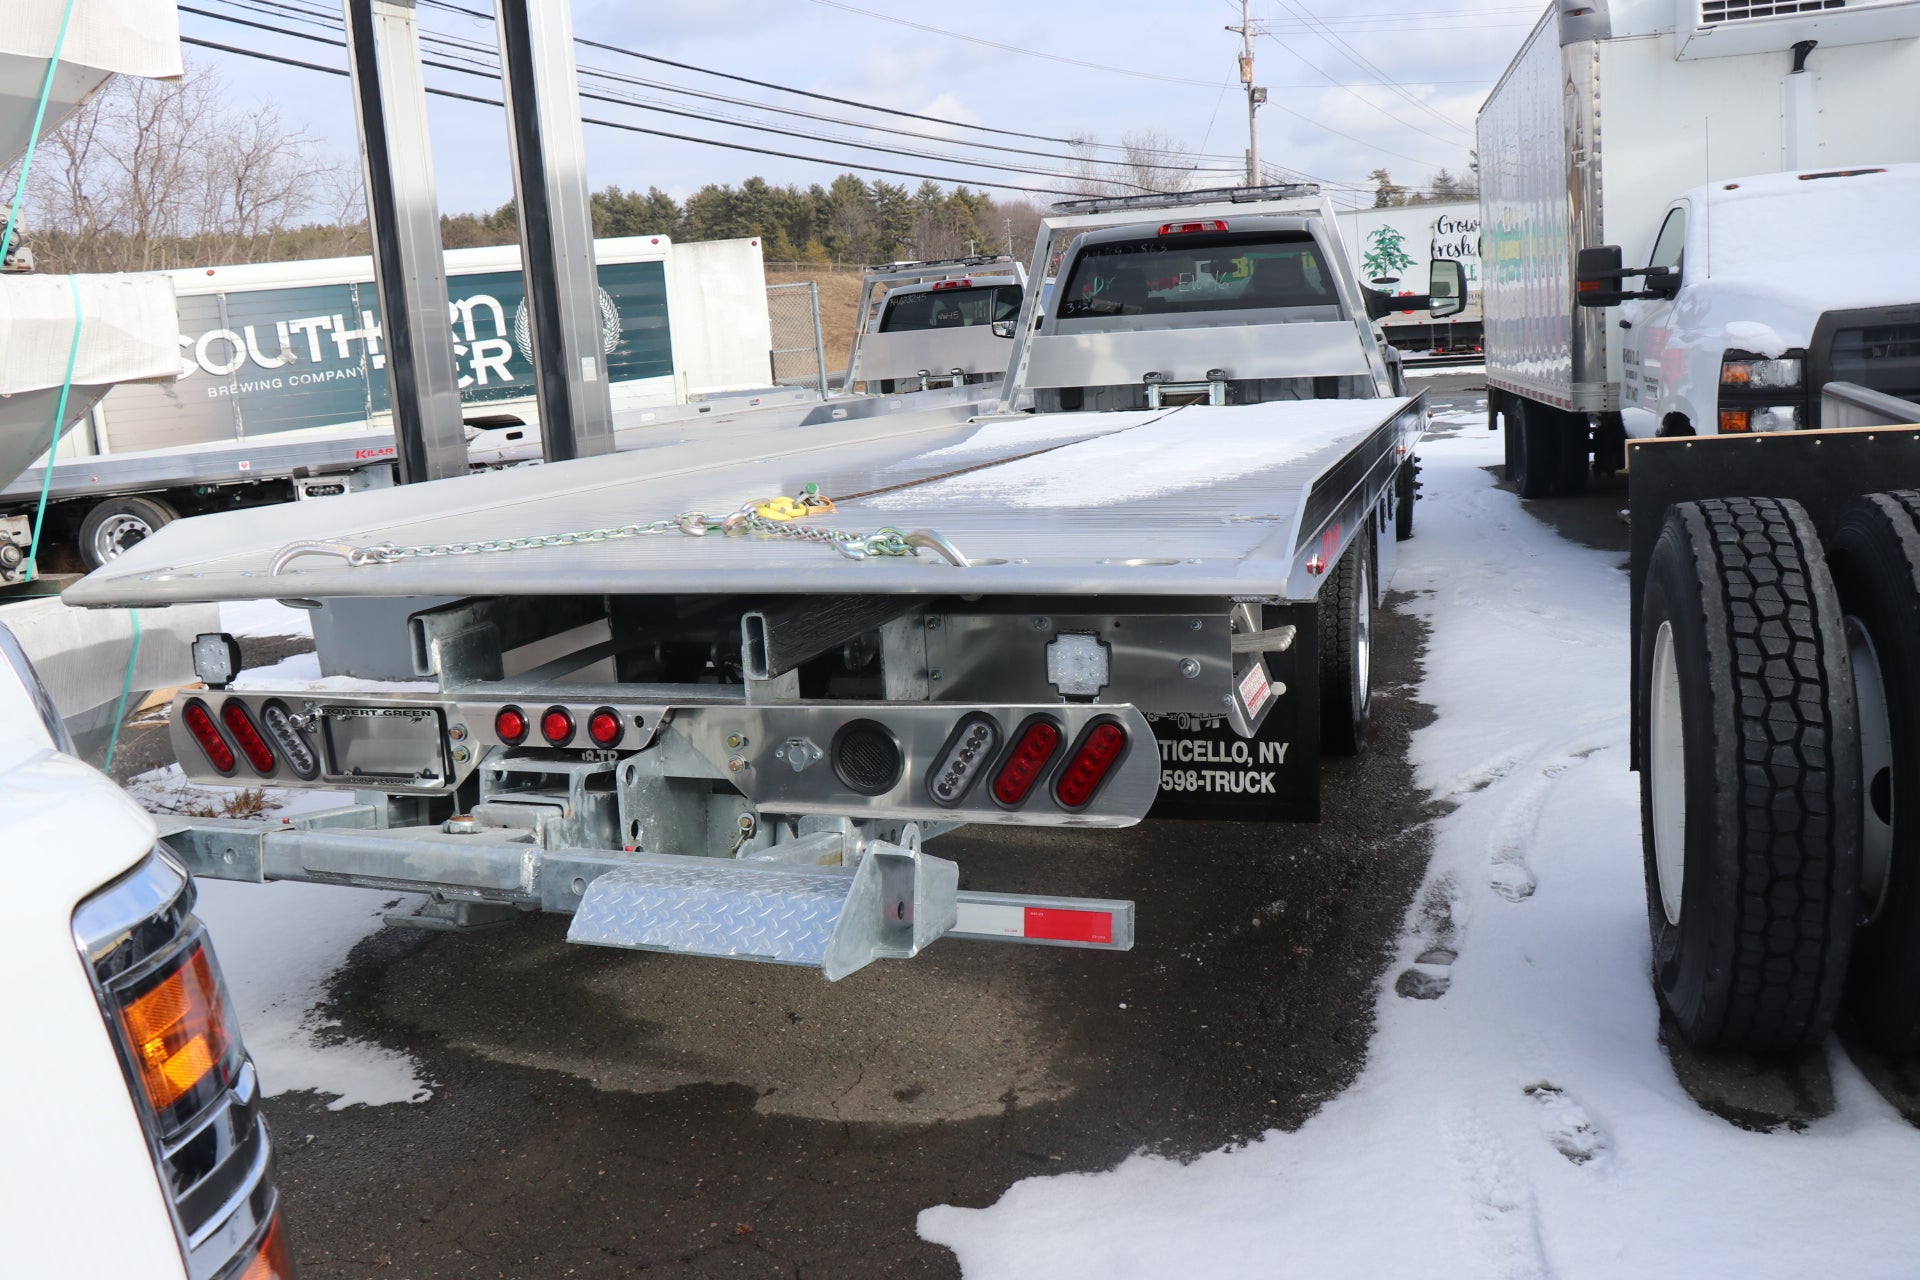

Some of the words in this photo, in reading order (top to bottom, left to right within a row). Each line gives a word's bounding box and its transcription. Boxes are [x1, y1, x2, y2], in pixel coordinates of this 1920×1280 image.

[1437, 214, 1480, 235] Grow
[207, 378, 283, 398] BREWING
[289, 366, 367, 386] COMPANY
[1259, 741, 1290, 764] NY
